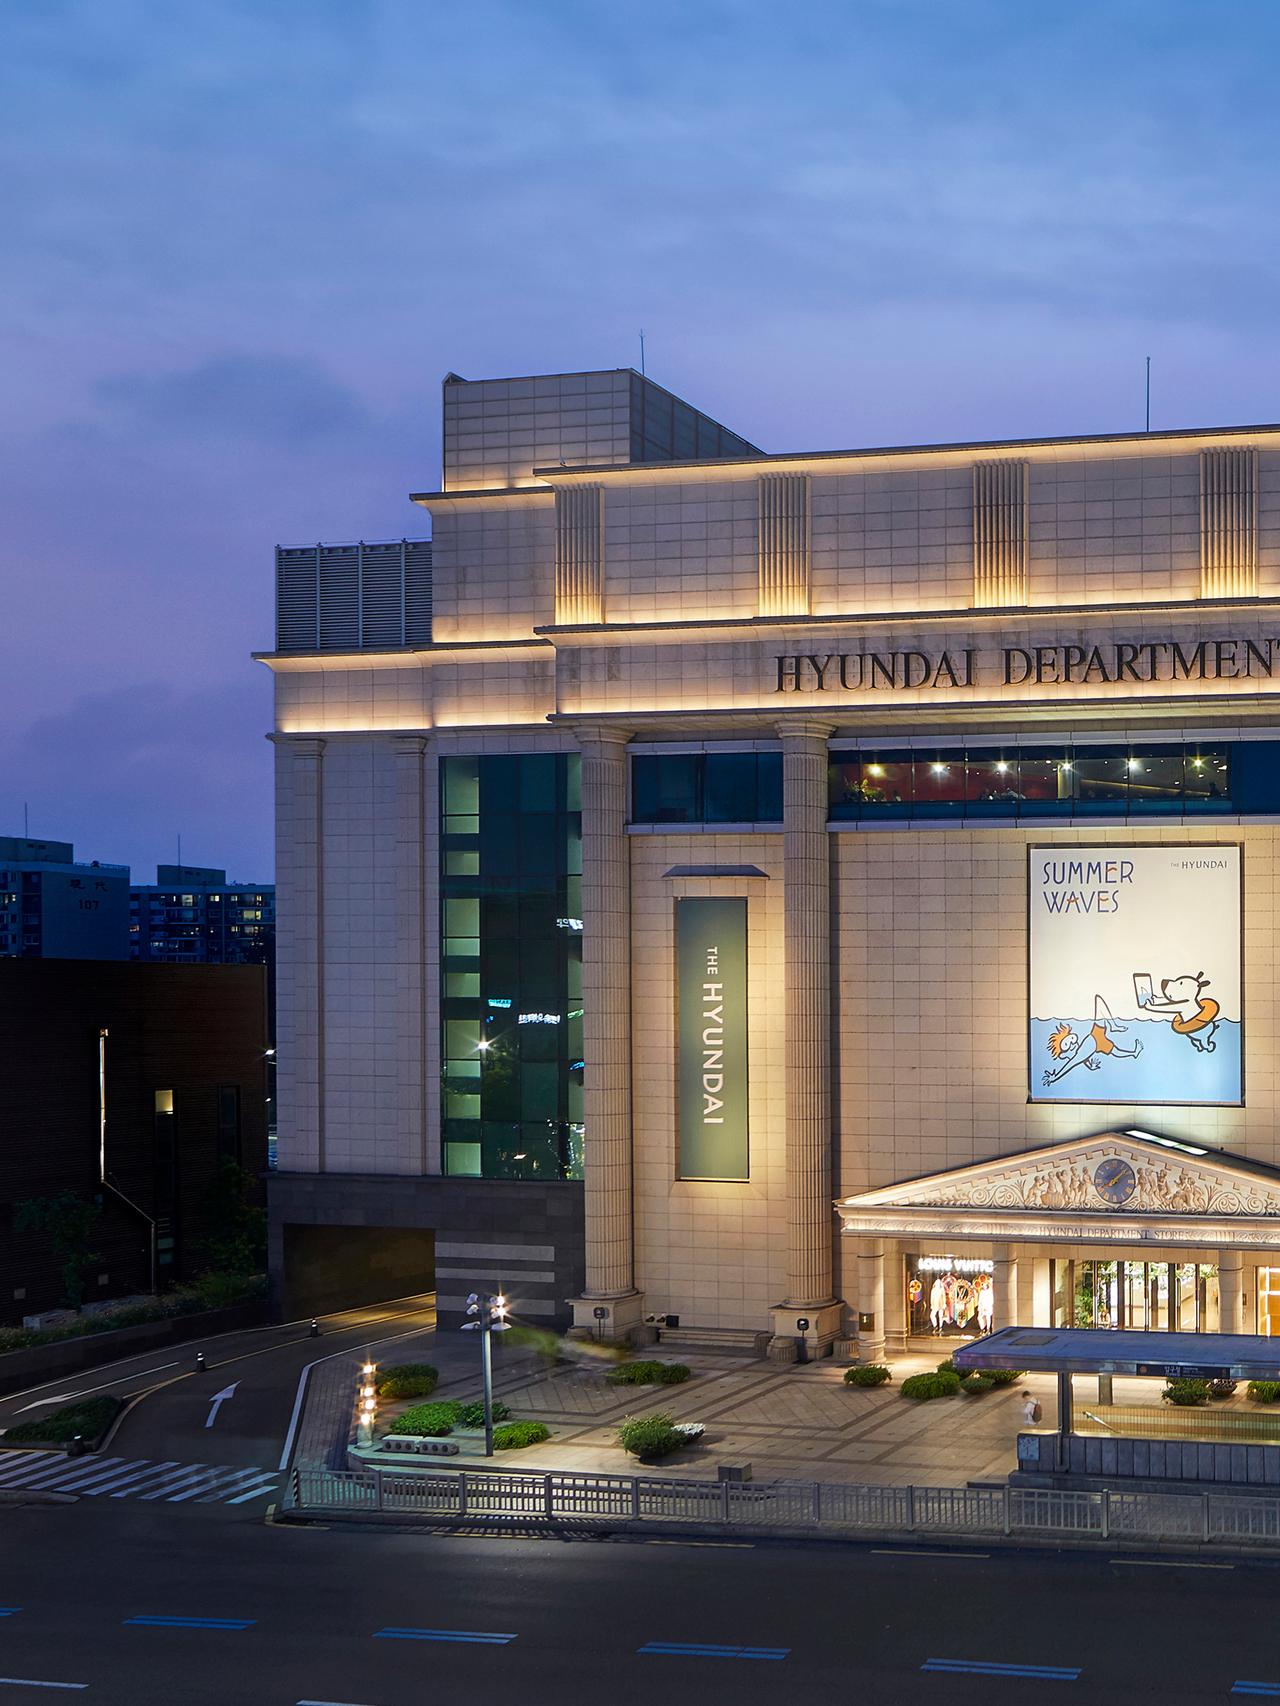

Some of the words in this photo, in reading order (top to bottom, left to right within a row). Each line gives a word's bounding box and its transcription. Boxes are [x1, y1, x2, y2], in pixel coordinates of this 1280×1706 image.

[774, 649, 982, 692] HYUNDAI
[1042, 860, 1134, 885] SUMMER
[1181, 860, 1228, 869] HYUNDAI
[80, 899, 99, 910] 107
[1042, 889, 1119, 914] WAVES
[707, 946, 718, 975] THE
[702, 983, 724, 1124] HYUNDAI
[1040, 1224, 1083, 1238] HYUNDAI
[1087, 1228, 1149, 1240] DEPARTMENT
[953, 1259, 994, 1272] VUITTO
